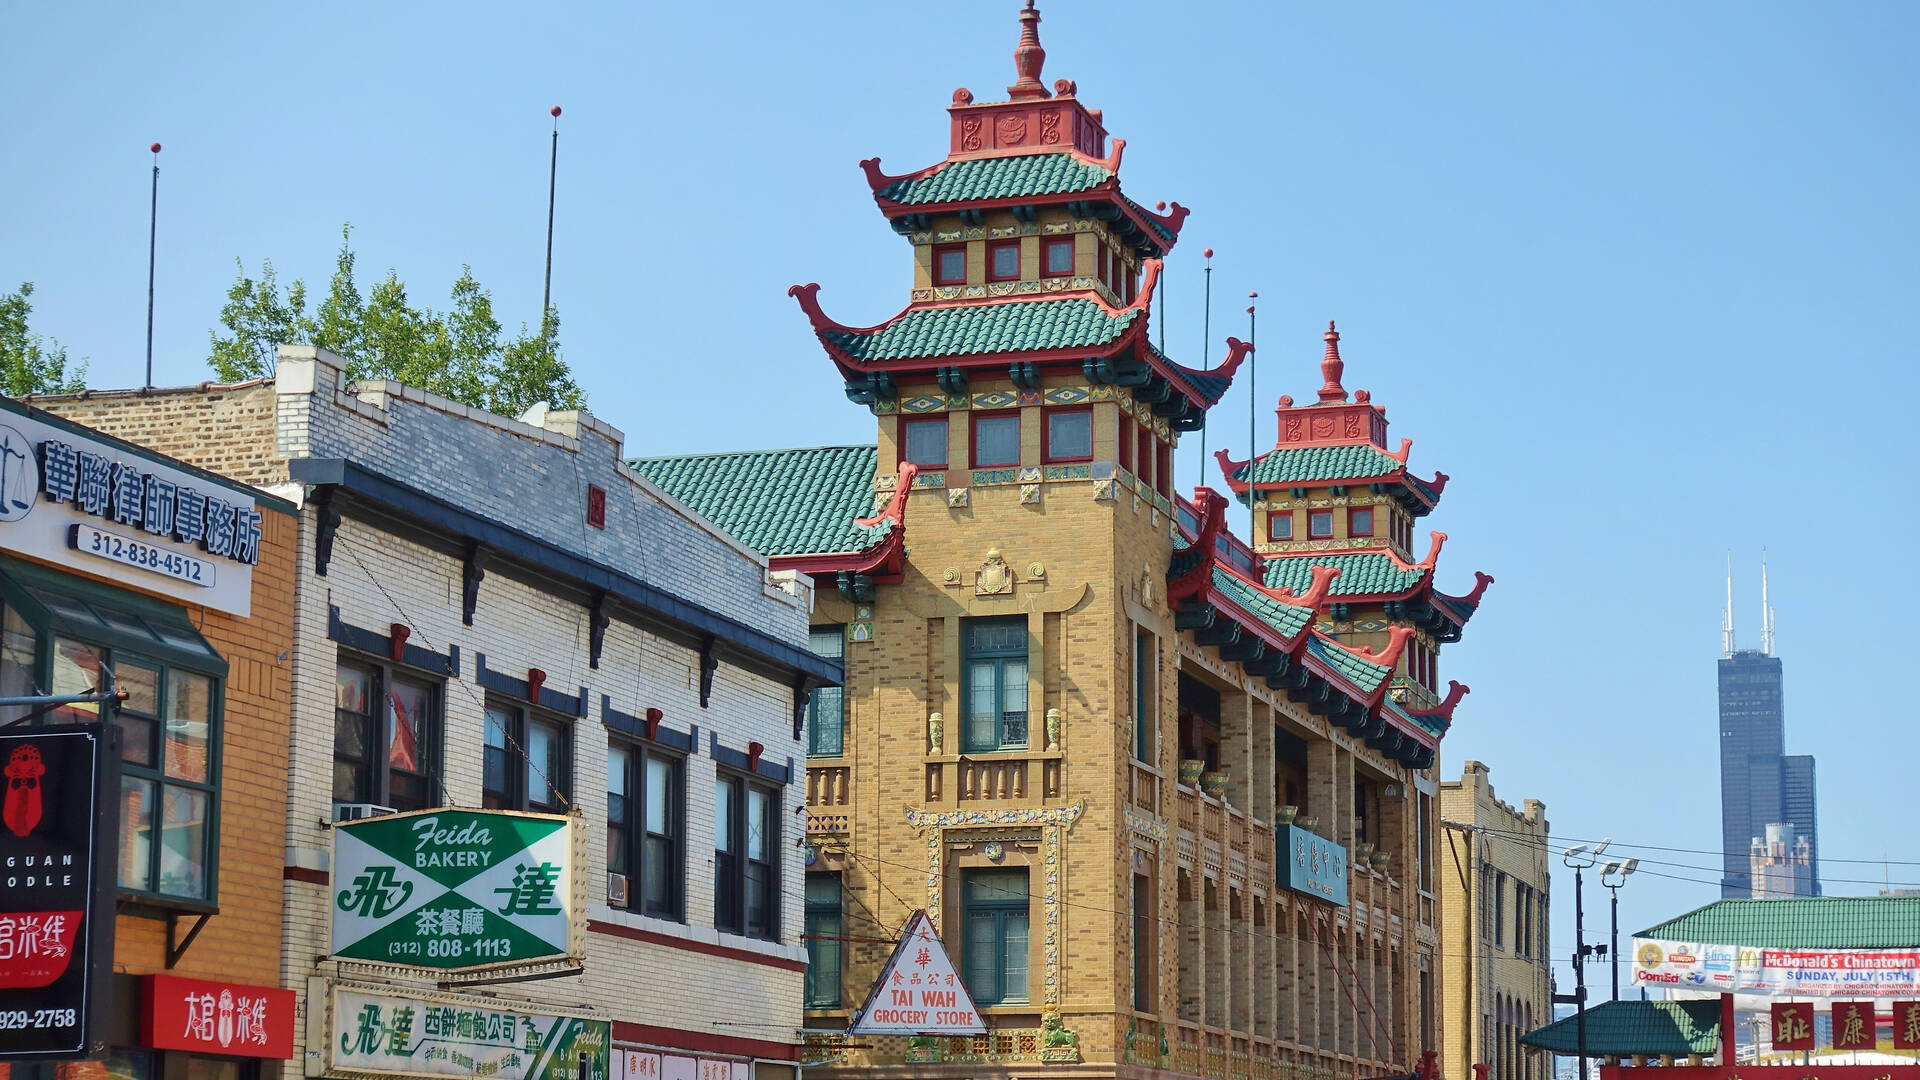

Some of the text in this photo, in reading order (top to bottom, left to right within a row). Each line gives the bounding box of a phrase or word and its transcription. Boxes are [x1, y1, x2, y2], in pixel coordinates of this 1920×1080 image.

[44, 440, 262, 565] 華聯律師事務所
[91, 532, 202, 581] 312-838-4512
[411, 816, 493, 851] Feida
[6, 854, 73, 868] GUAN
[415, 850, 492, 868] BAKERY
[415, 907, 485, 937] 茶餐廳
[388, 940, 421, 957] (312)
[1765, 953, 1916, 968] McDonald's Chinatown
[890, 970, 956, 988] 食品公司
[1638, 970, 1680, 983] ComEd
[1787, 970, 1915, 983] SUNDAY, JULY 15TH,
[890, 990, 957, 1009] TAI WAH
[873, 1008, 973, 1026] GROCERY STORE
[573, 1021, 603, 1048] Feida
